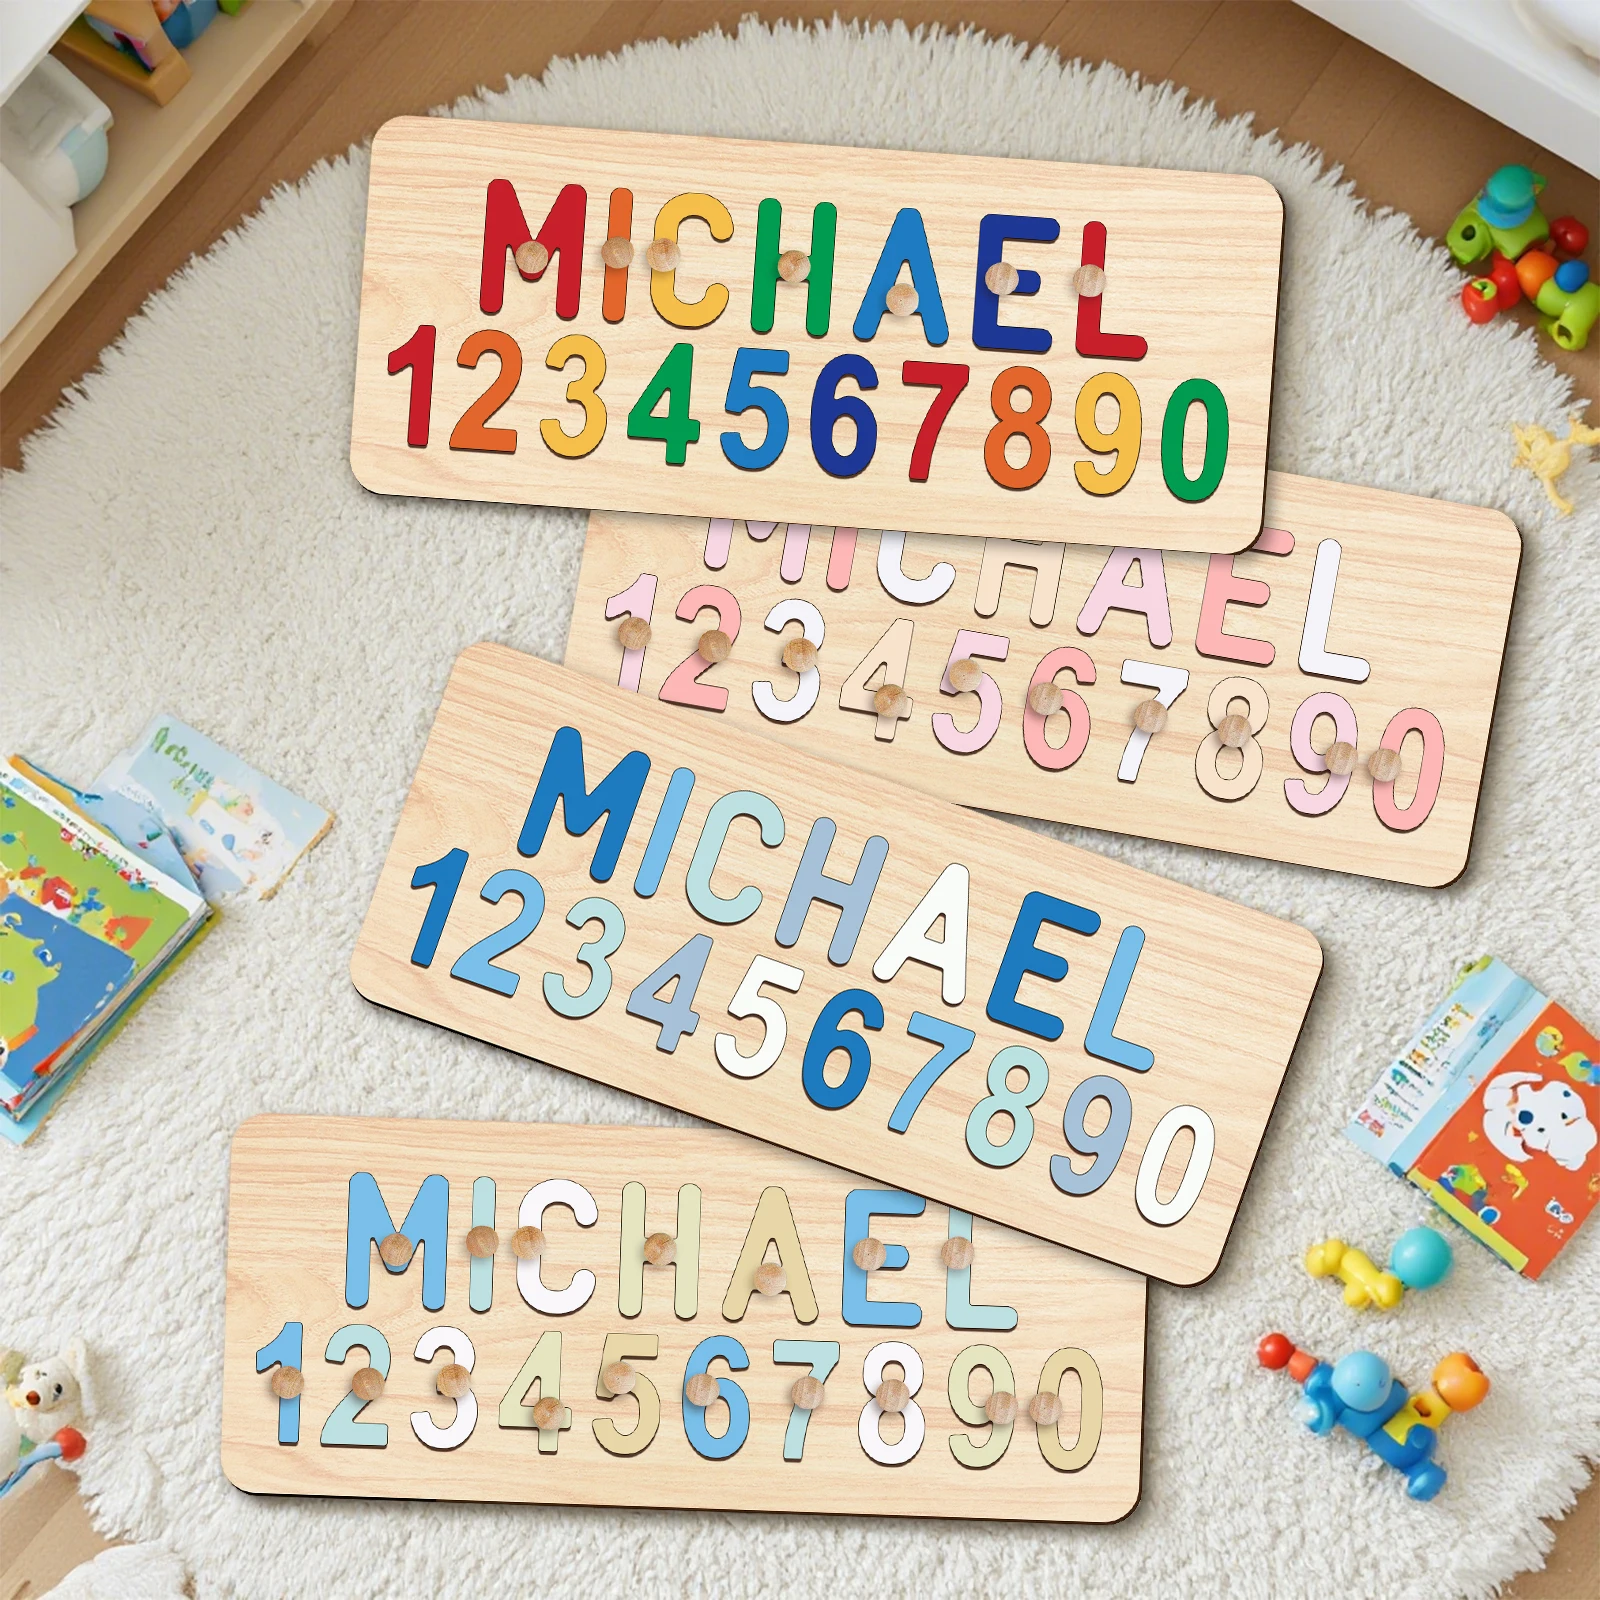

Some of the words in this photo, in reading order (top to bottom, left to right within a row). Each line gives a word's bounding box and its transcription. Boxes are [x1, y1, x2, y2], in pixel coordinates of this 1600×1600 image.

[479, 178, 1148, 360] MICHAEL
[387, 325, 1229, 502] 1234567890
[605, 573, 1445, 832] 1234567890
[517, 726, 1154, 1072] MICHAEL
[410, 848, 1216, 1226] 1234567890
[345, 1172, 1018, 1331] MICHAEL
[255, 1322, 1104, 1472] 1234567890
